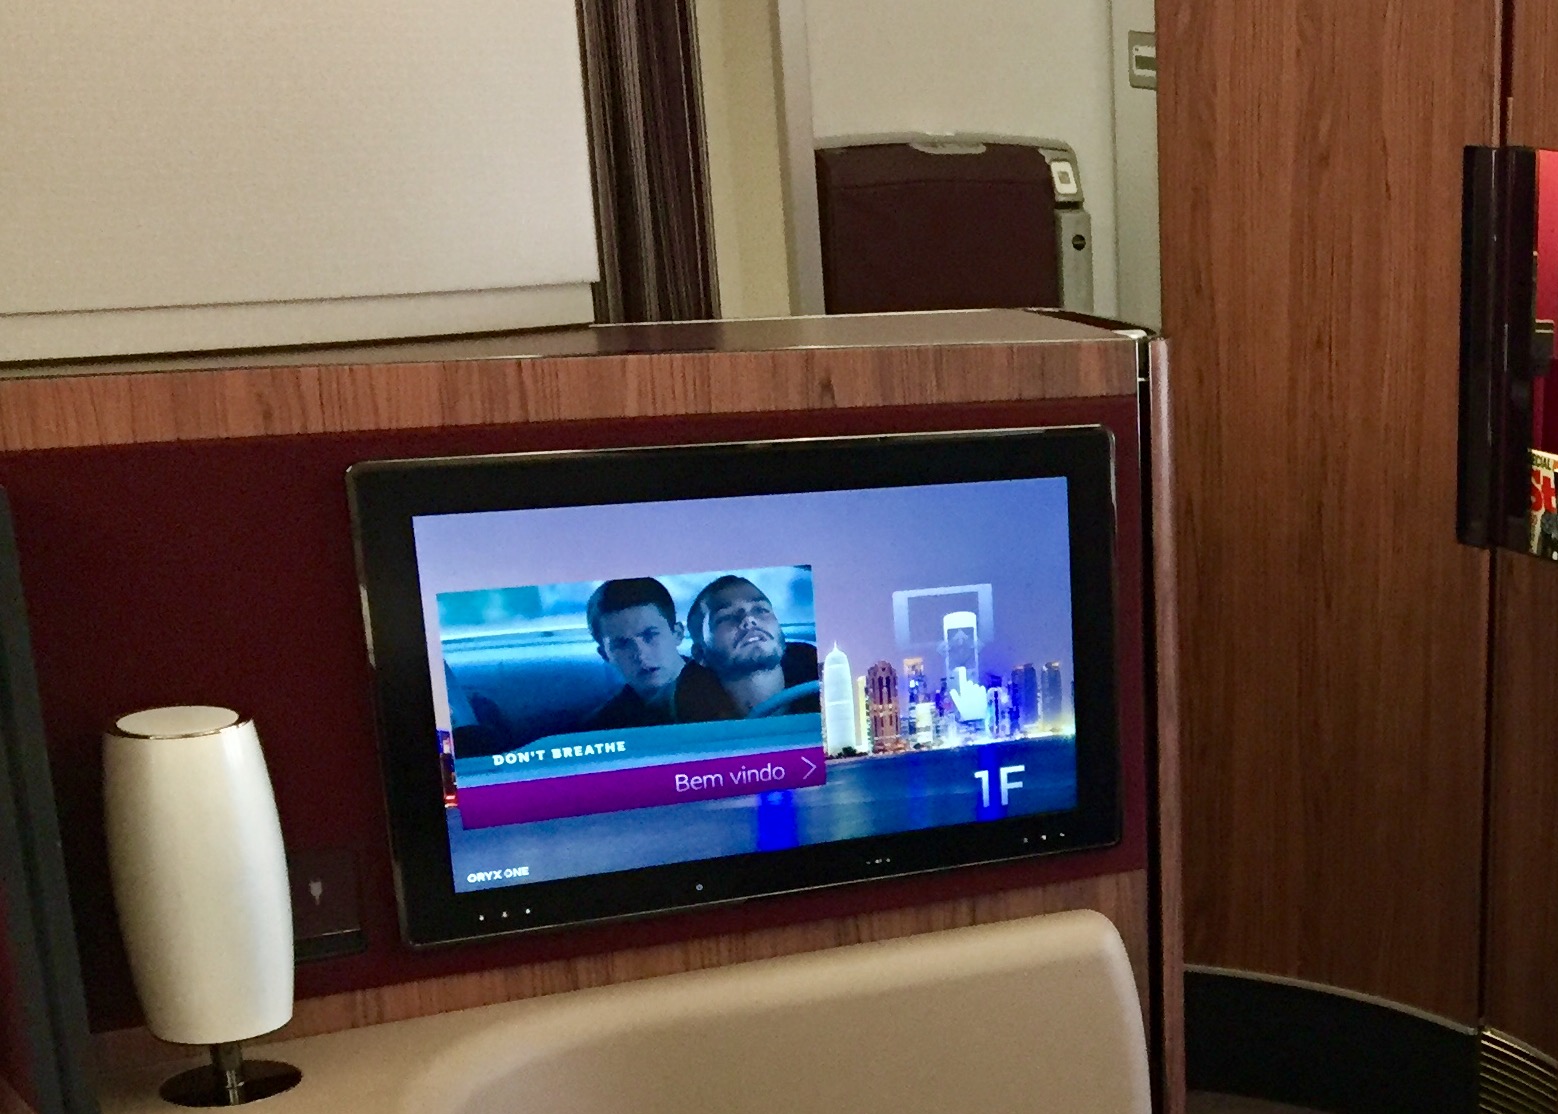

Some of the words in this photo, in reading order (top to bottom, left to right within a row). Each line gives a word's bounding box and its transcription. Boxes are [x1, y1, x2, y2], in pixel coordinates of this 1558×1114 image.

[492, 749, 546, 766] DON'T
[551, 740, 627, 760] BREATHE
[675, 773, 724, 793] Bem
[729, 762, 786, 785] vindo
[974, 764, 1026, 808] 1F
[466, 869, 503, 883] ORYX
[503, 866, 530, 879] ONE
